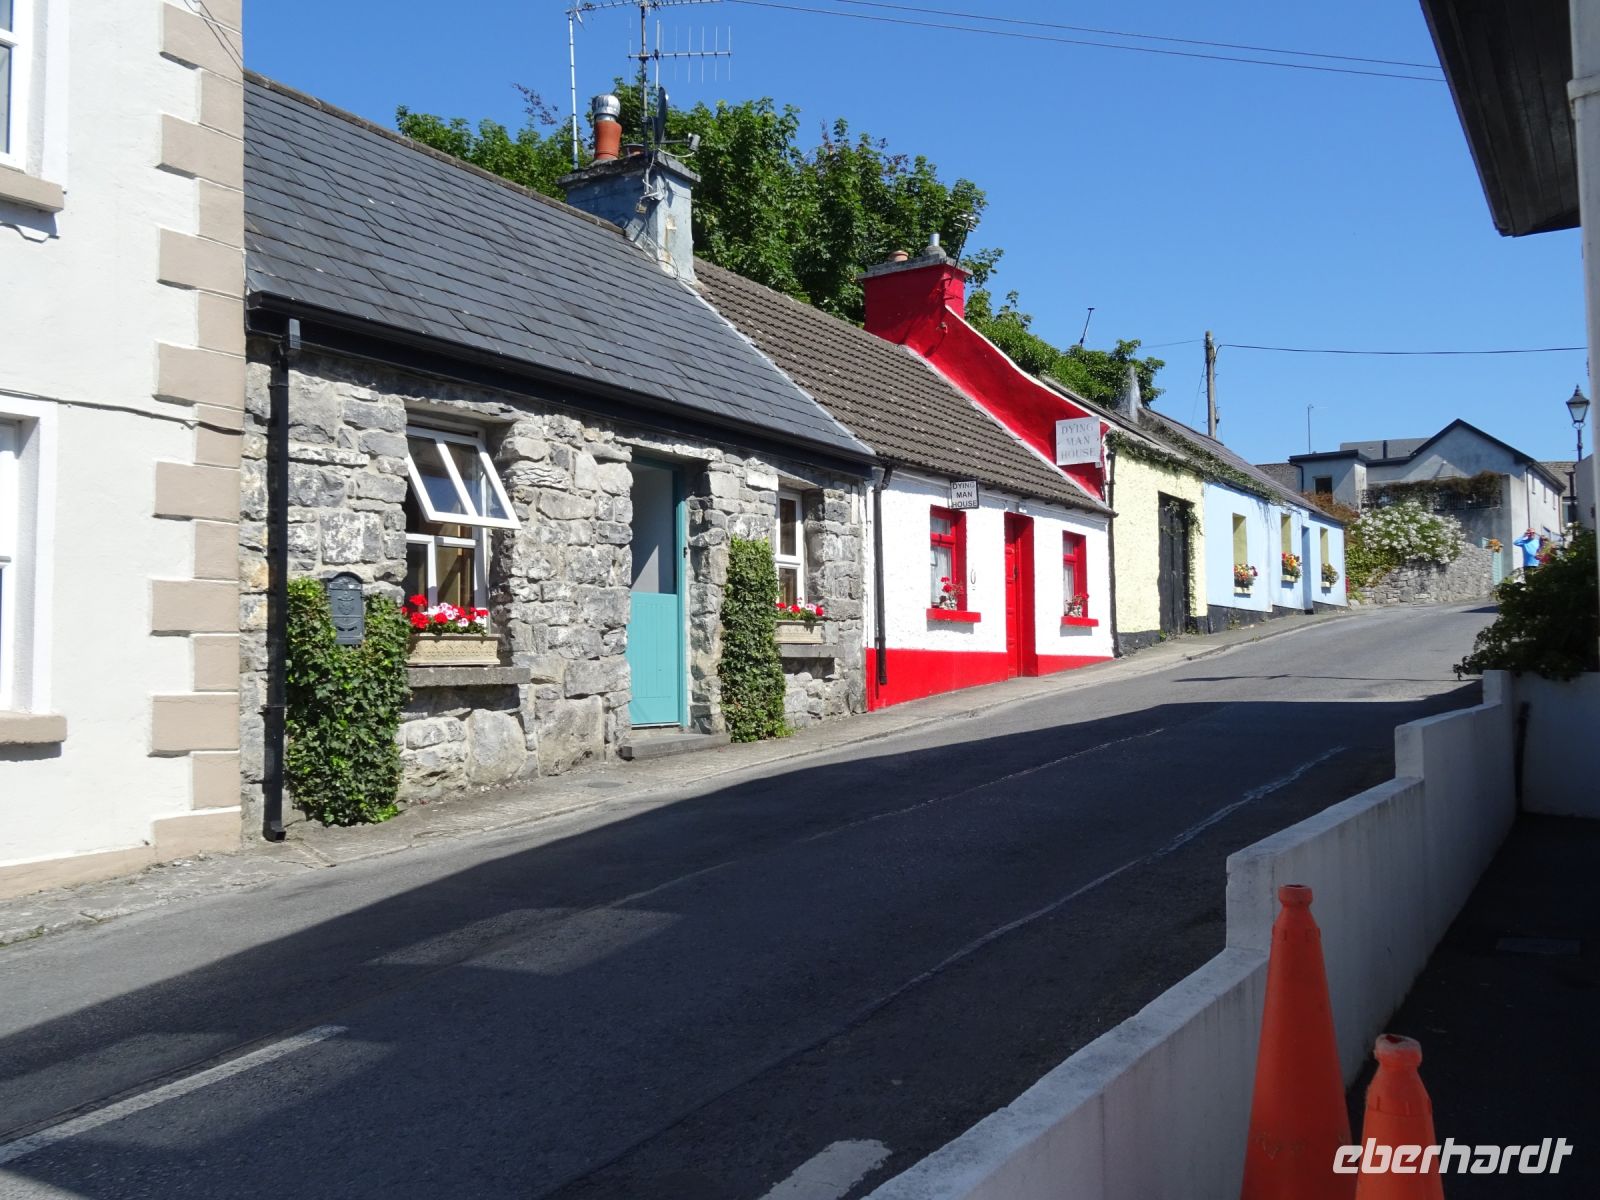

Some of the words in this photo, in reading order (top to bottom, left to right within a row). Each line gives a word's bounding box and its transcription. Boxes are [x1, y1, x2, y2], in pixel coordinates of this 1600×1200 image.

[1061, 423, 1094, 435] DYING
[1061, 447, 1096, 459] HOUSE
[952, 481, 976, 489] DYING
[951, 500, 977, 508] HOUSE
